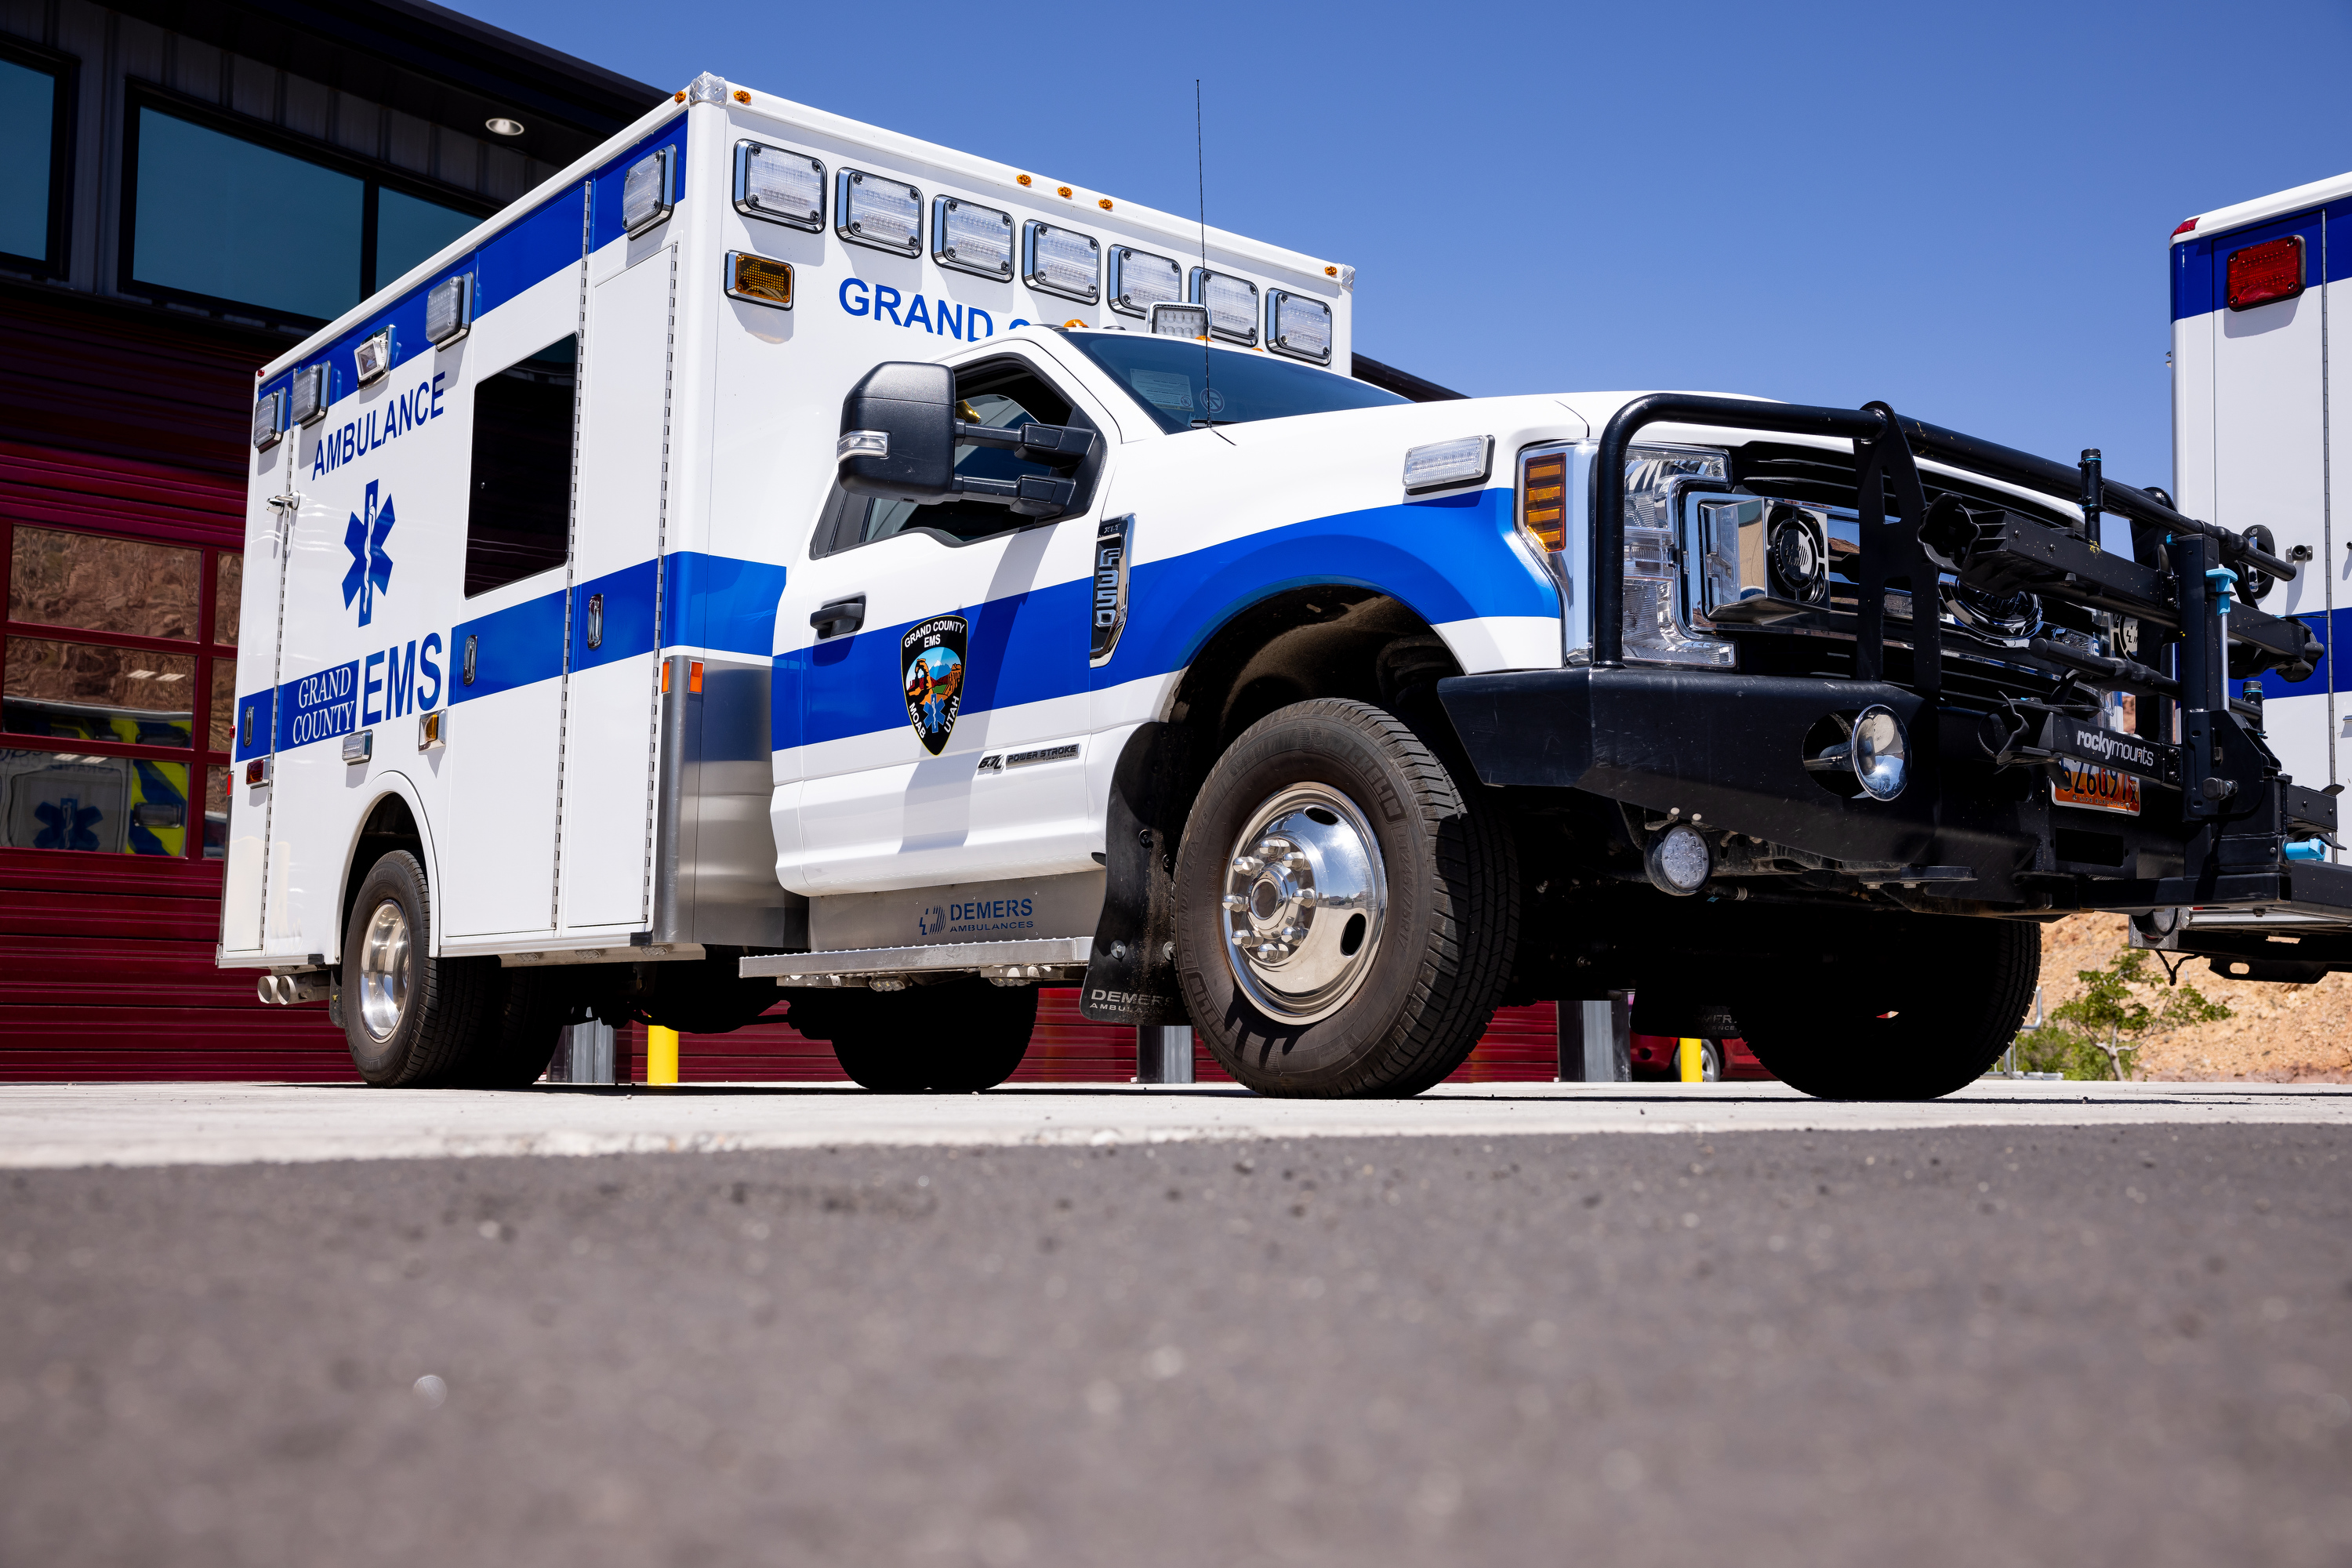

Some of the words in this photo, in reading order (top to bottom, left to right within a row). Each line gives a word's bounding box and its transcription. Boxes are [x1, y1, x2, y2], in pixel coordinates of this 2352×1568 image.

[839, 278, 993, 343] GRAND
[312, 371, 445, 481] AMBULANCE
[1104, 524, 1121, 534] XLT
[1095, 547, 1121, 628] F350
[904, 623, 931, 648] GRAND
[932, 620, 965, 633] COUNTY
[924, 633, 941, 648] EMS
[298, 666, 352, 709] GRAND
[361, 632, 442, 728] EMS
[292, 700, 354, 745] COUNTY
[909, 702, 927, 739] MOAB
[943, 695, 960, 734] UTAH
[1007, 751, 1038, 763] POWER
[1039, 745, 1076, 757] STROKE
[2076, 730, 2154, 767] rockymounts
[2095, 798, 2124, 808] ELEVATED
[949, 920, 1034, 933] AMBULANCES
[950, 898, 1033, 921] DEMERS
[1180, 873, 1194, 964] DEFENDER
[1091, 989, 1174, 1006] DEMERS
